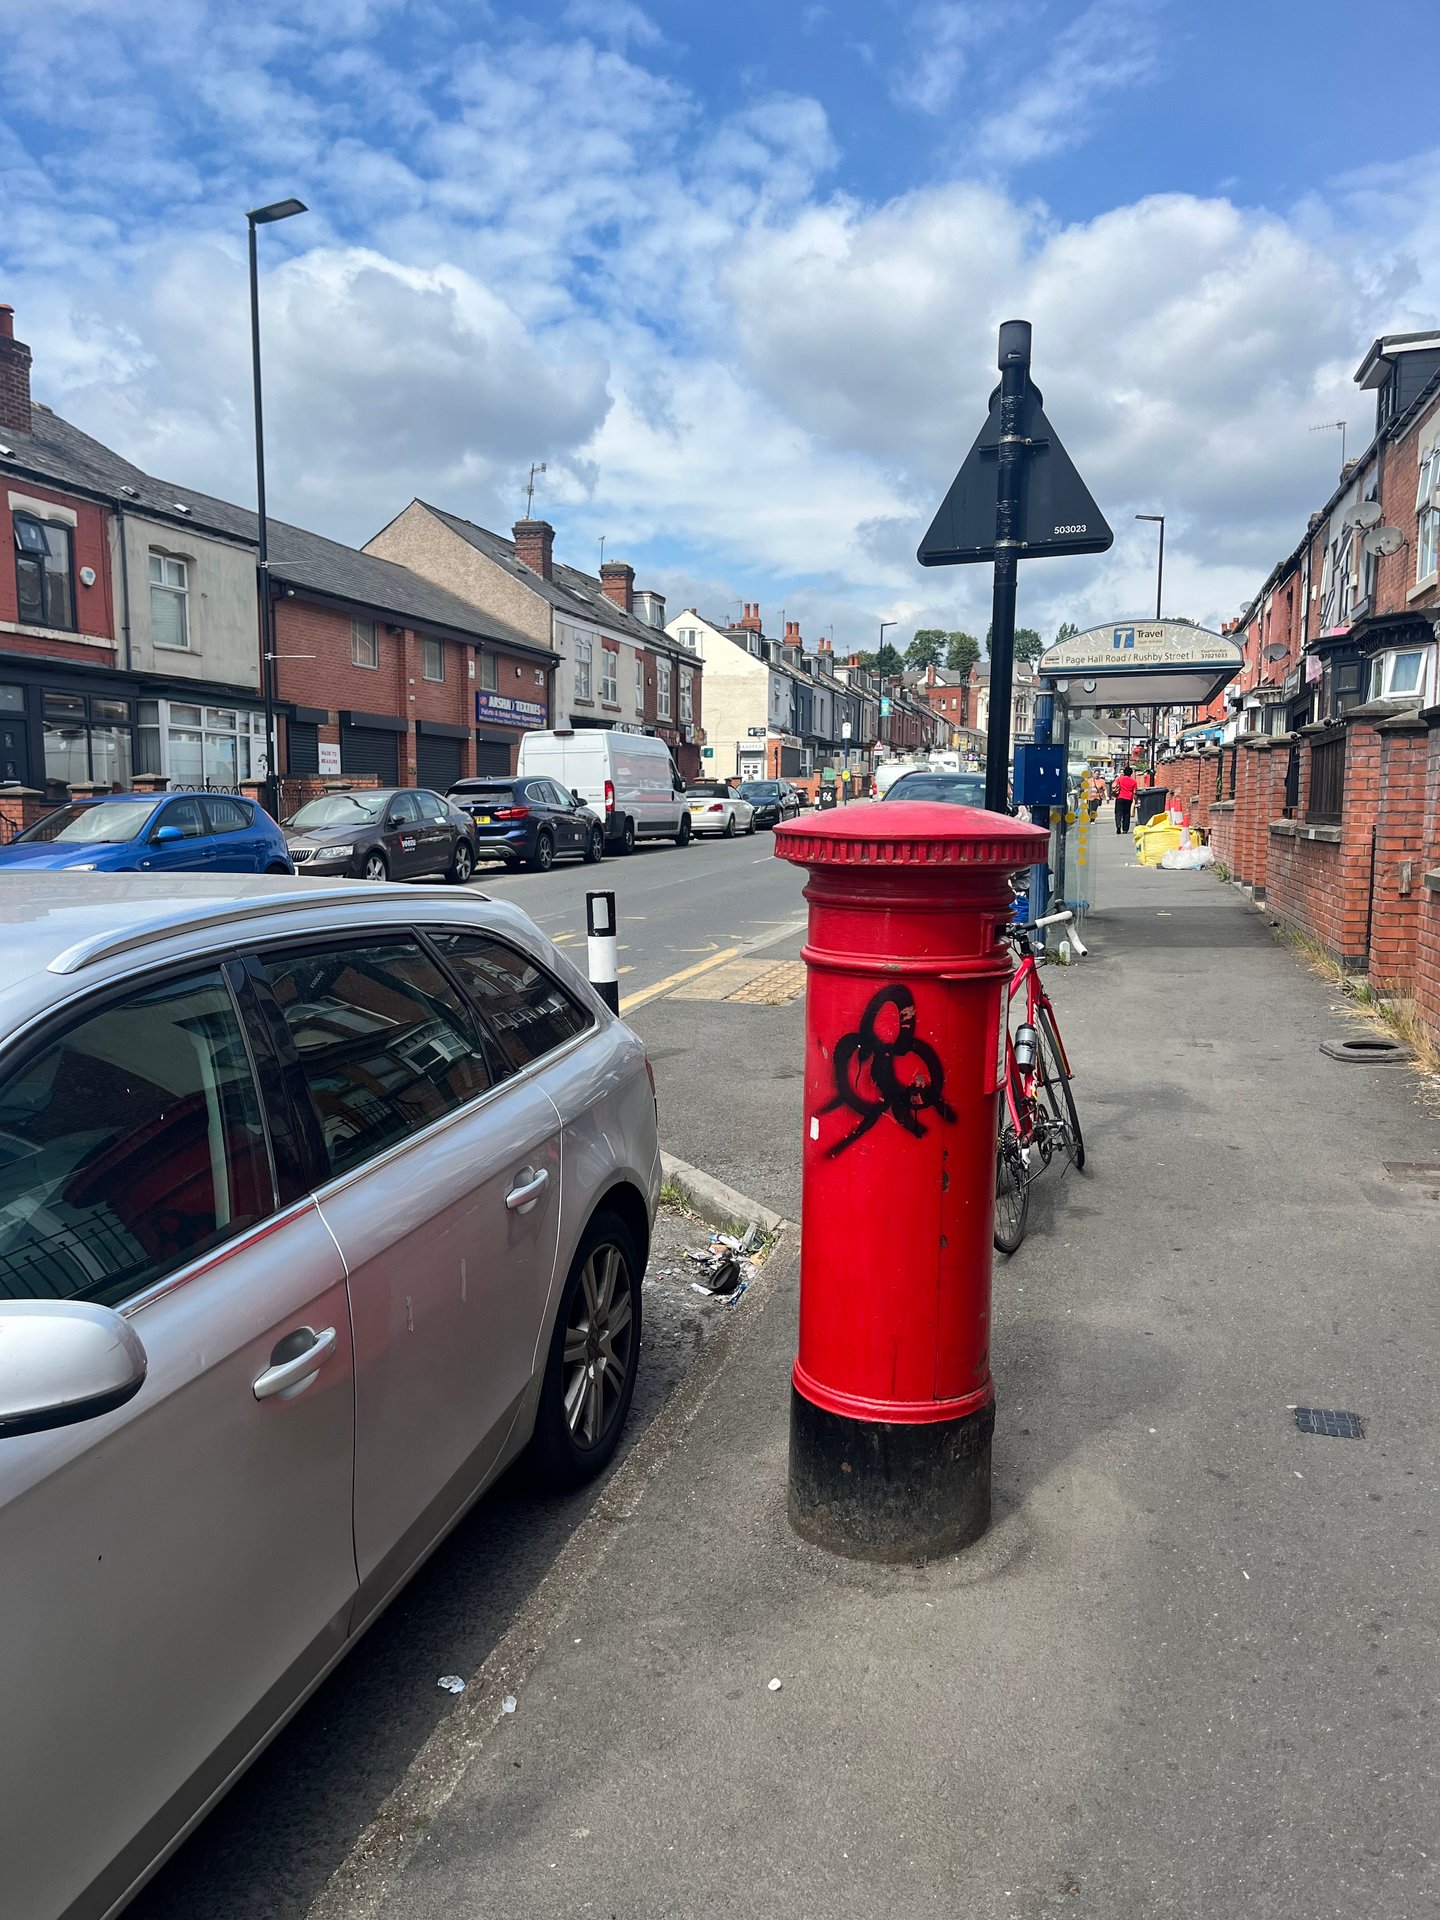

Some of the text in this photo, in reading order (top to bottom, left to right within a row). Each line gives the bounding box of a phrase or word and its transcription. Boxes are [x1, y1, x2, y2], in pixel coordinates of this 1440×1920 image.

[1054, 524, 1087, 535] 503023
[1137, 630, 1163, 639] Travel
[1066, 656, 1085, 665] Page
[1087, 655, 1103, 663] Hall
[1105, 653, 1126, 662] Road
[1133, 653, 1162, 662] Rushby
[1164, 651, 1190, 660] Street
